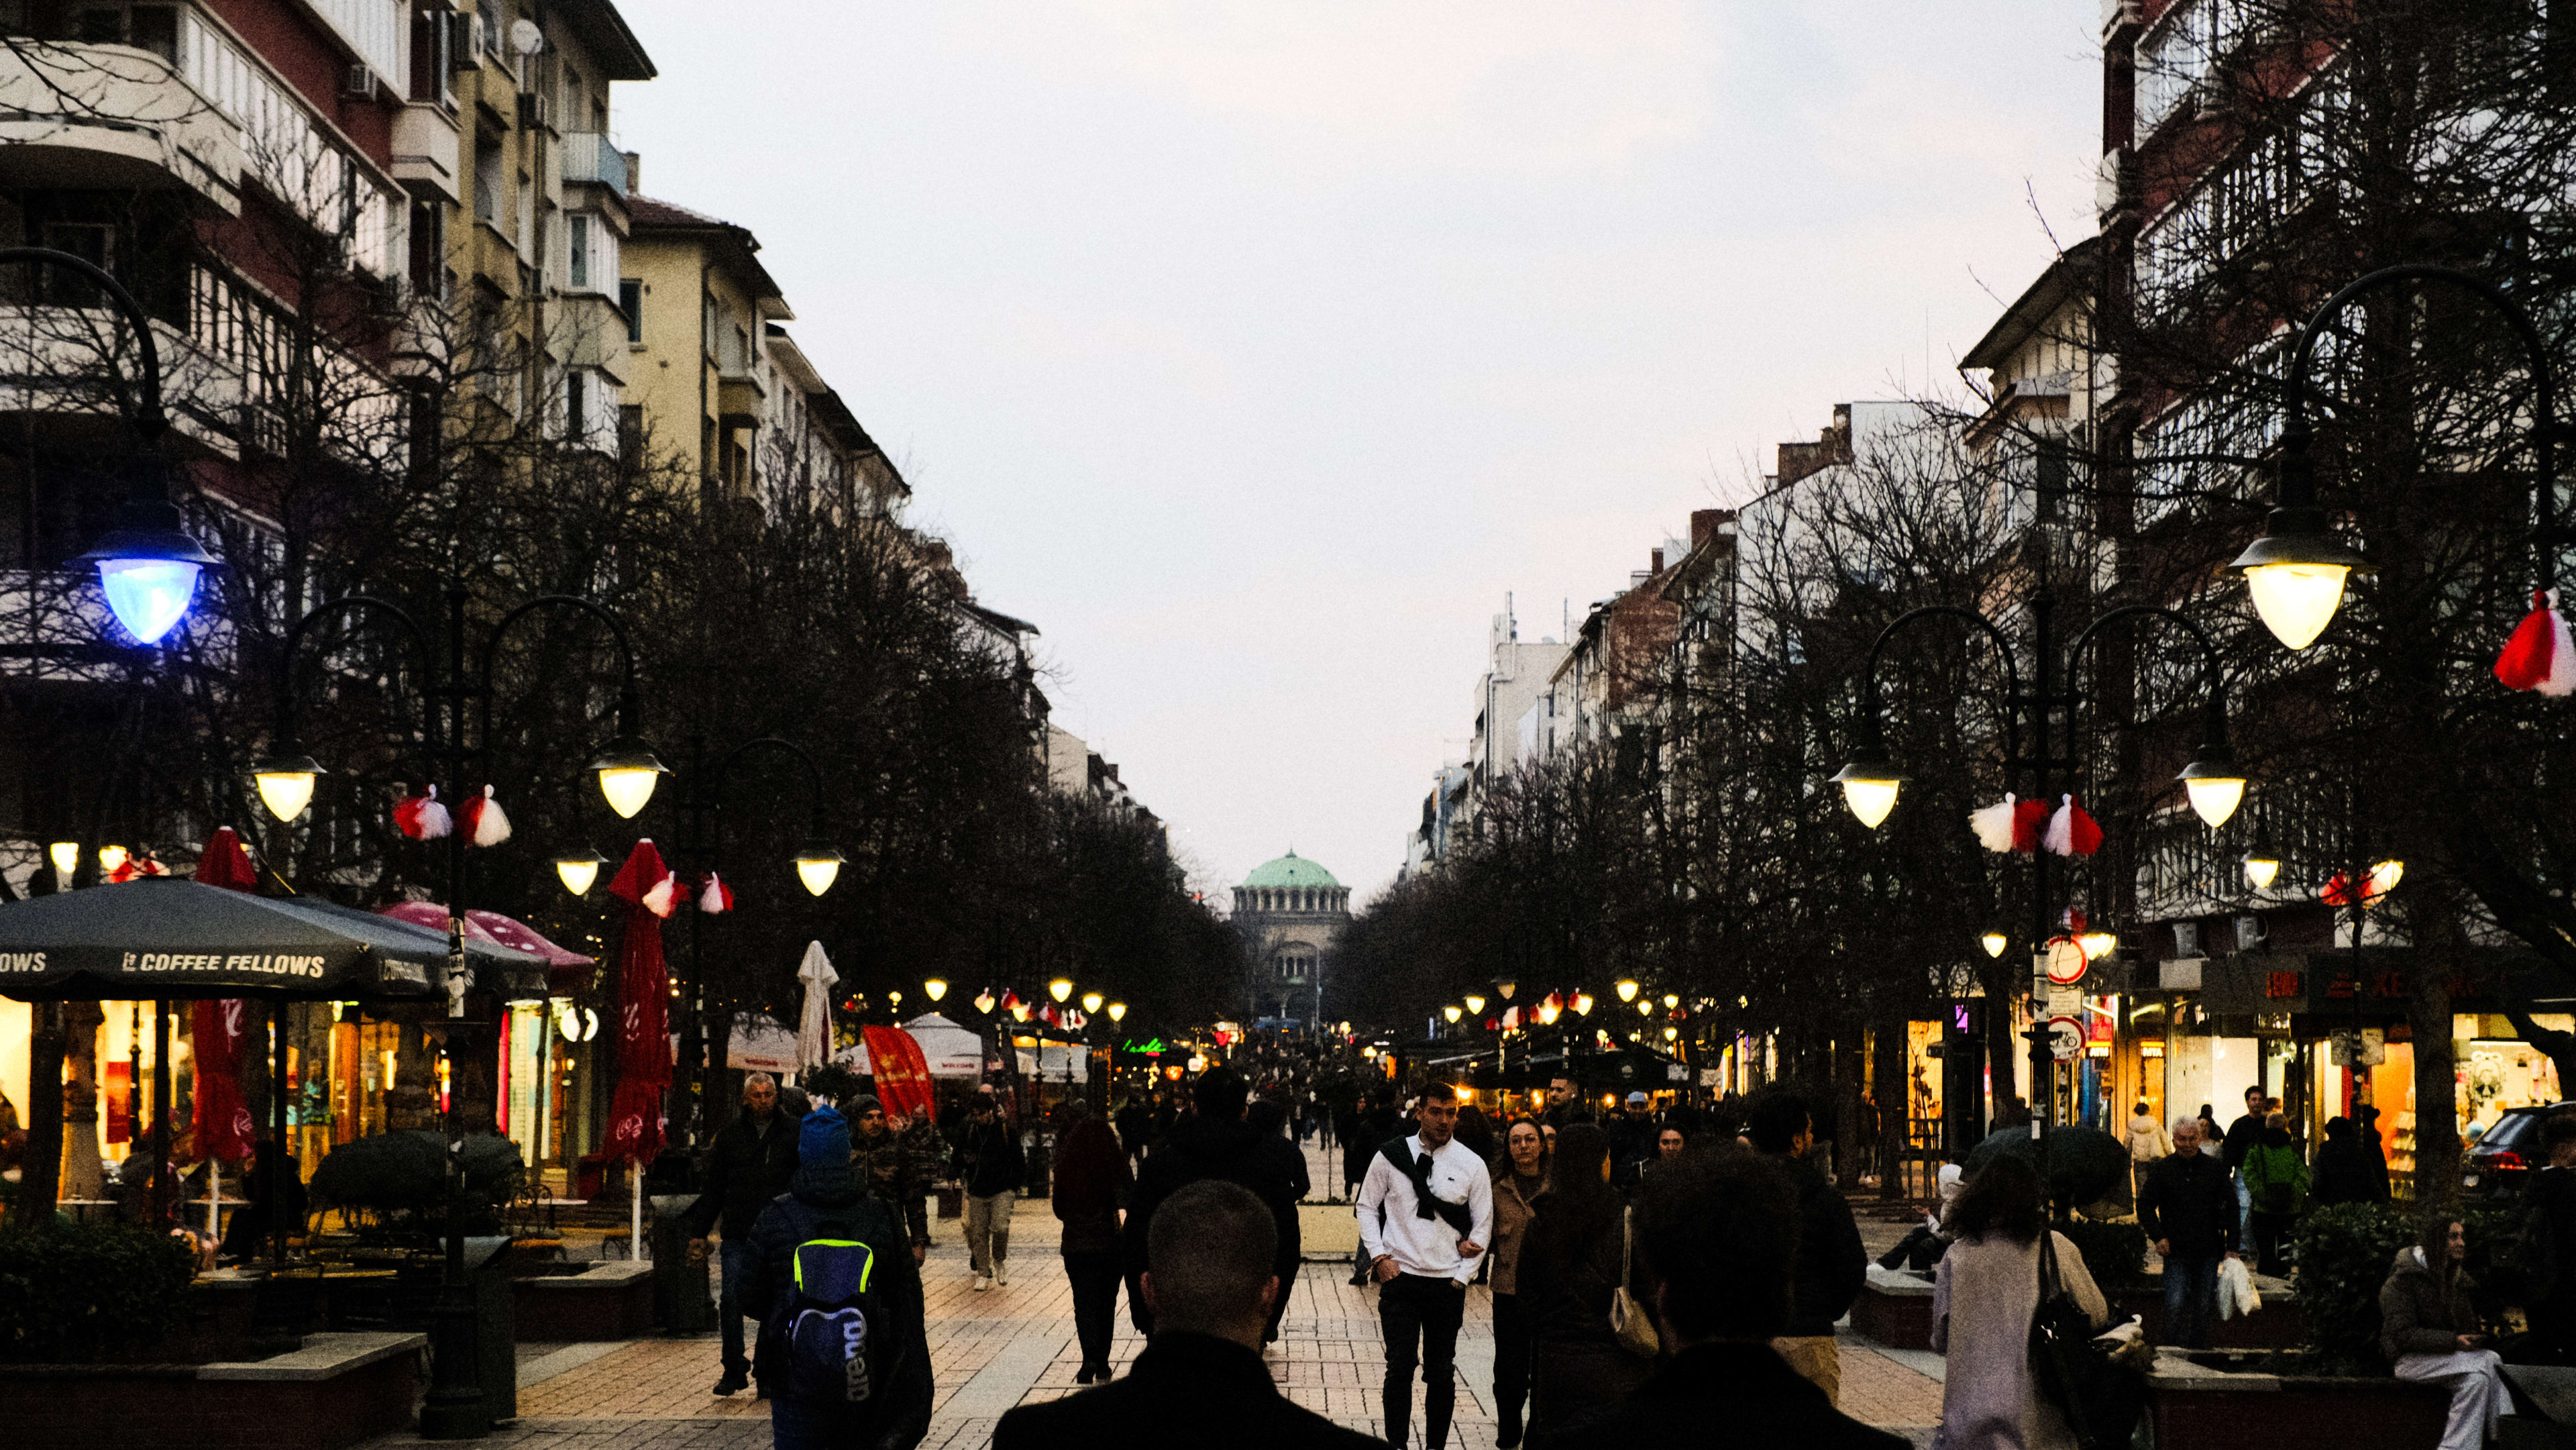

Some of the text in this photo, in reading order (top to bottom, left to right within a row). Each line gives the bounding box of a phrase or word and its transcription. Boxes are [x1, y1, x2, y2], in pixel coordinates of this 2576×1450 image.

[140, 953, 221, 972] COFFEE
[225, 954, 325, 978] FELLOWS
[2090, 1047, 2108, 1057] ATM
[843, 1320, 870, 1402] arena
